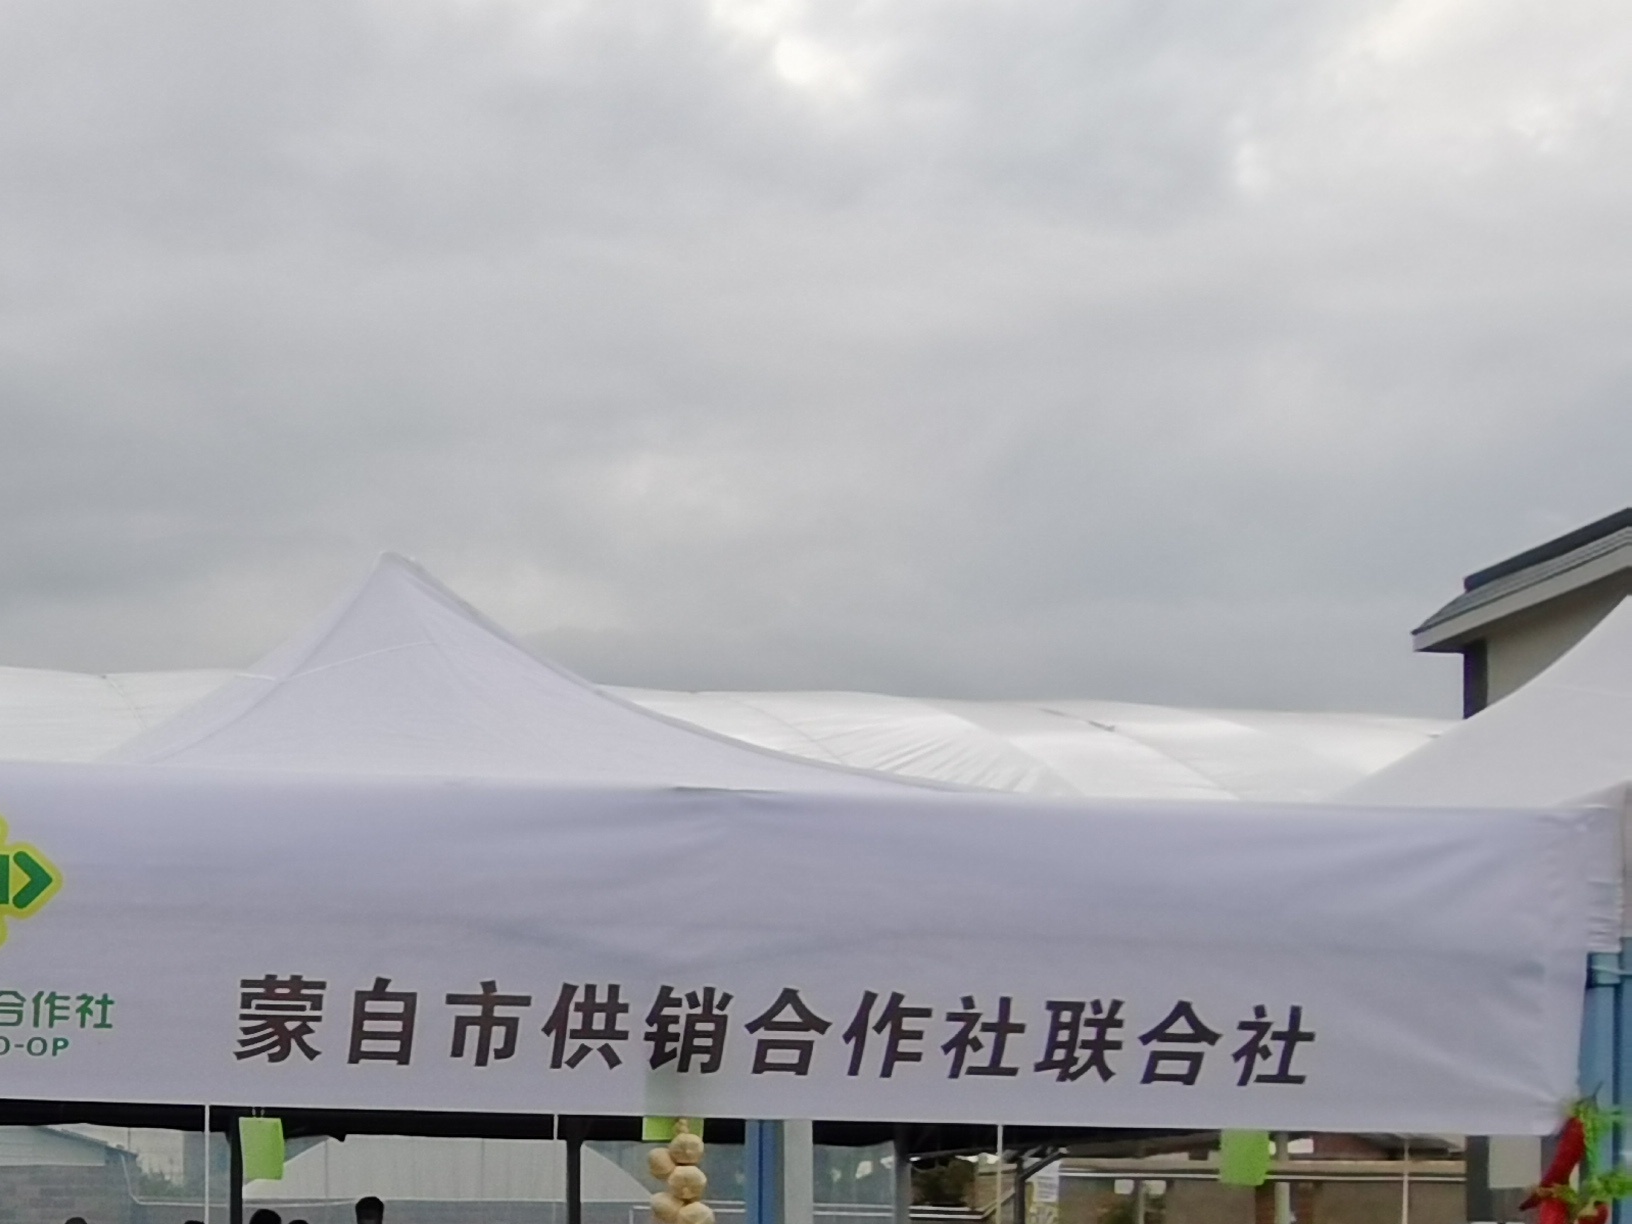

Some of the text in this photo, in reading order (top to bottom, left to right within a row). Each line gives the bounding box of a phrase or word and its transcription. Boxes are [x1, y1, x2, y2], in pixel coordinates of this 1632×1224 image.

[234, 973, 1316, 1087] 蒙自市供销合作社联合社
